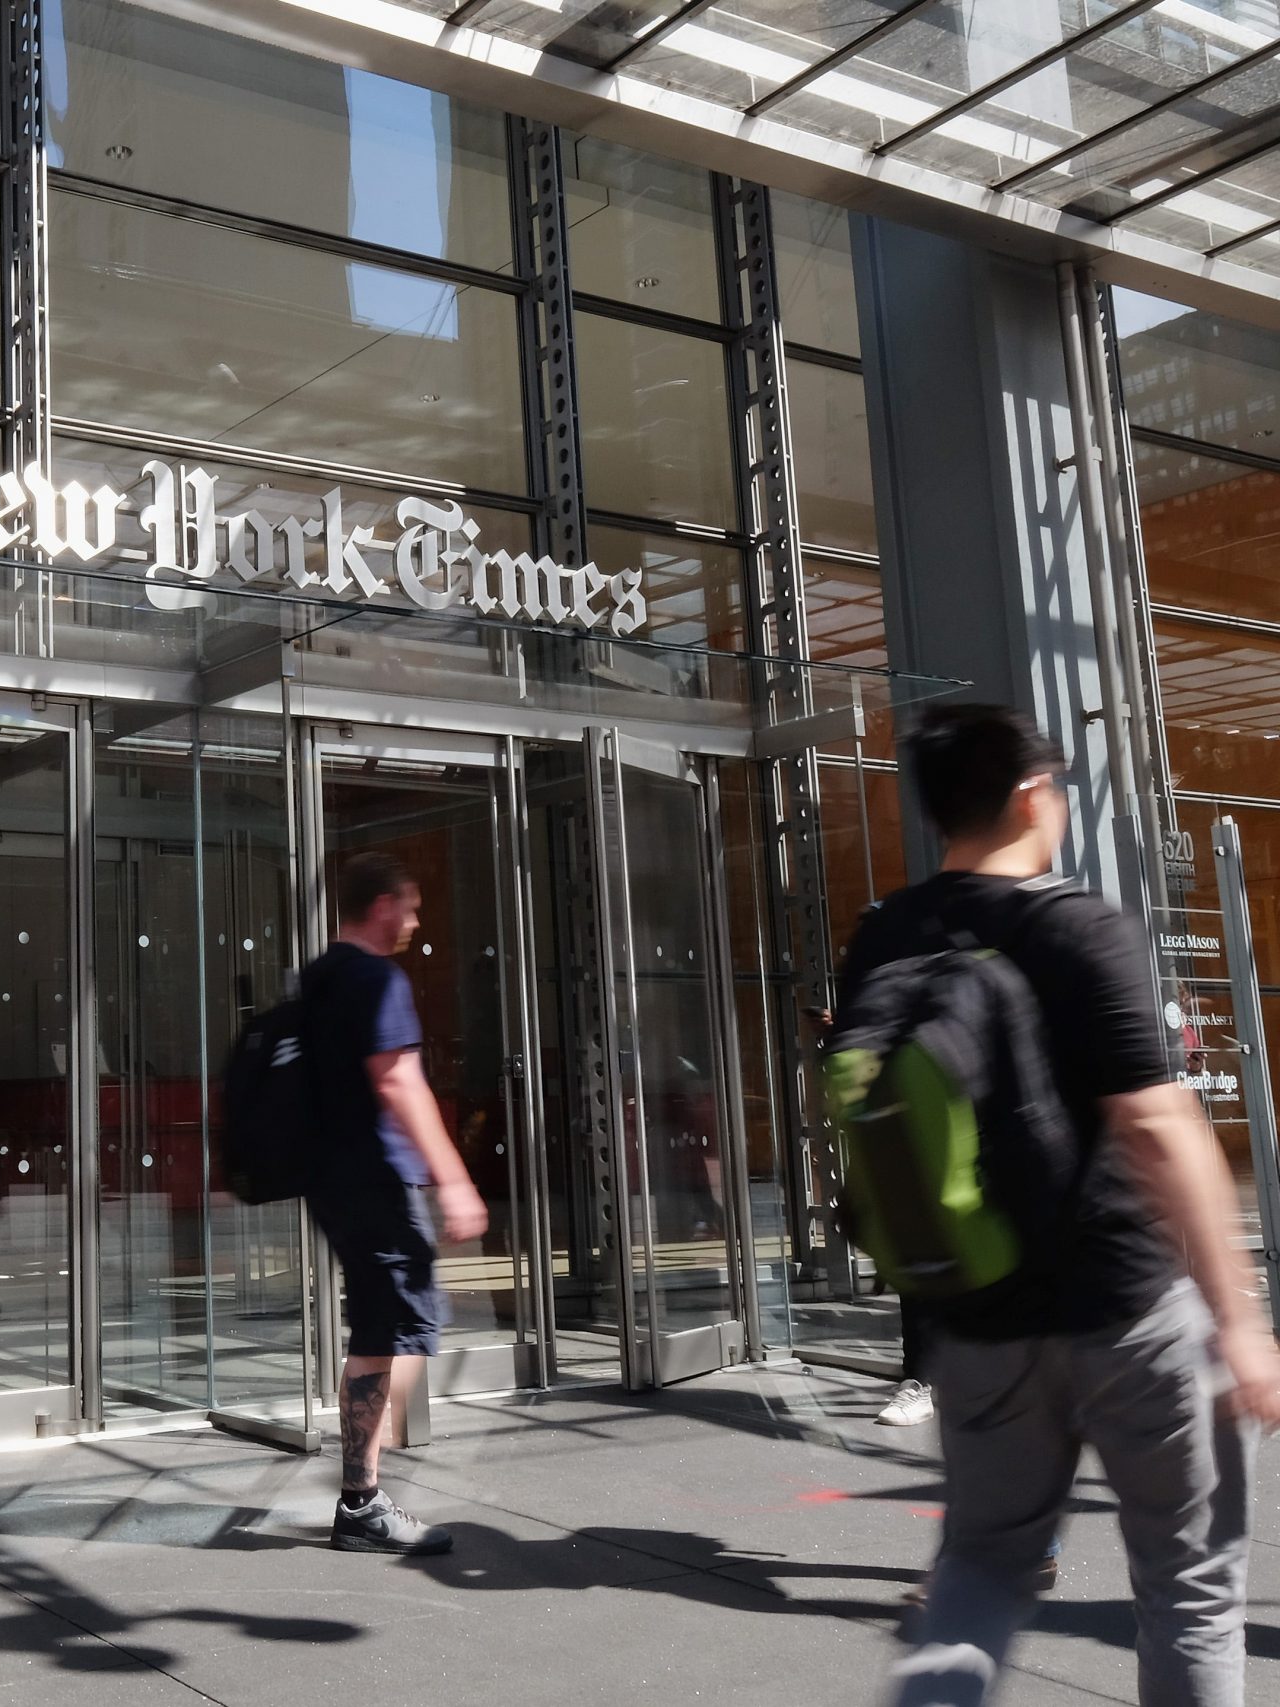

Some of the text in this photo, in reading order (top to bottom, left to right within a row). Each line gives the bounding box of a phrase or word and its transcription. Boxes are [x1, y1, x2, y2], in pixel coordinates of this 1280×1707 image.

[139, 459, 385, 611] York
[393, 496, 649, 638] Times
[1163, 831, 1195, 862] 620
[1159, 933, 1220, 949] LEGG MASON
[1176, 1070, 1238, 1094] ClearBridge
